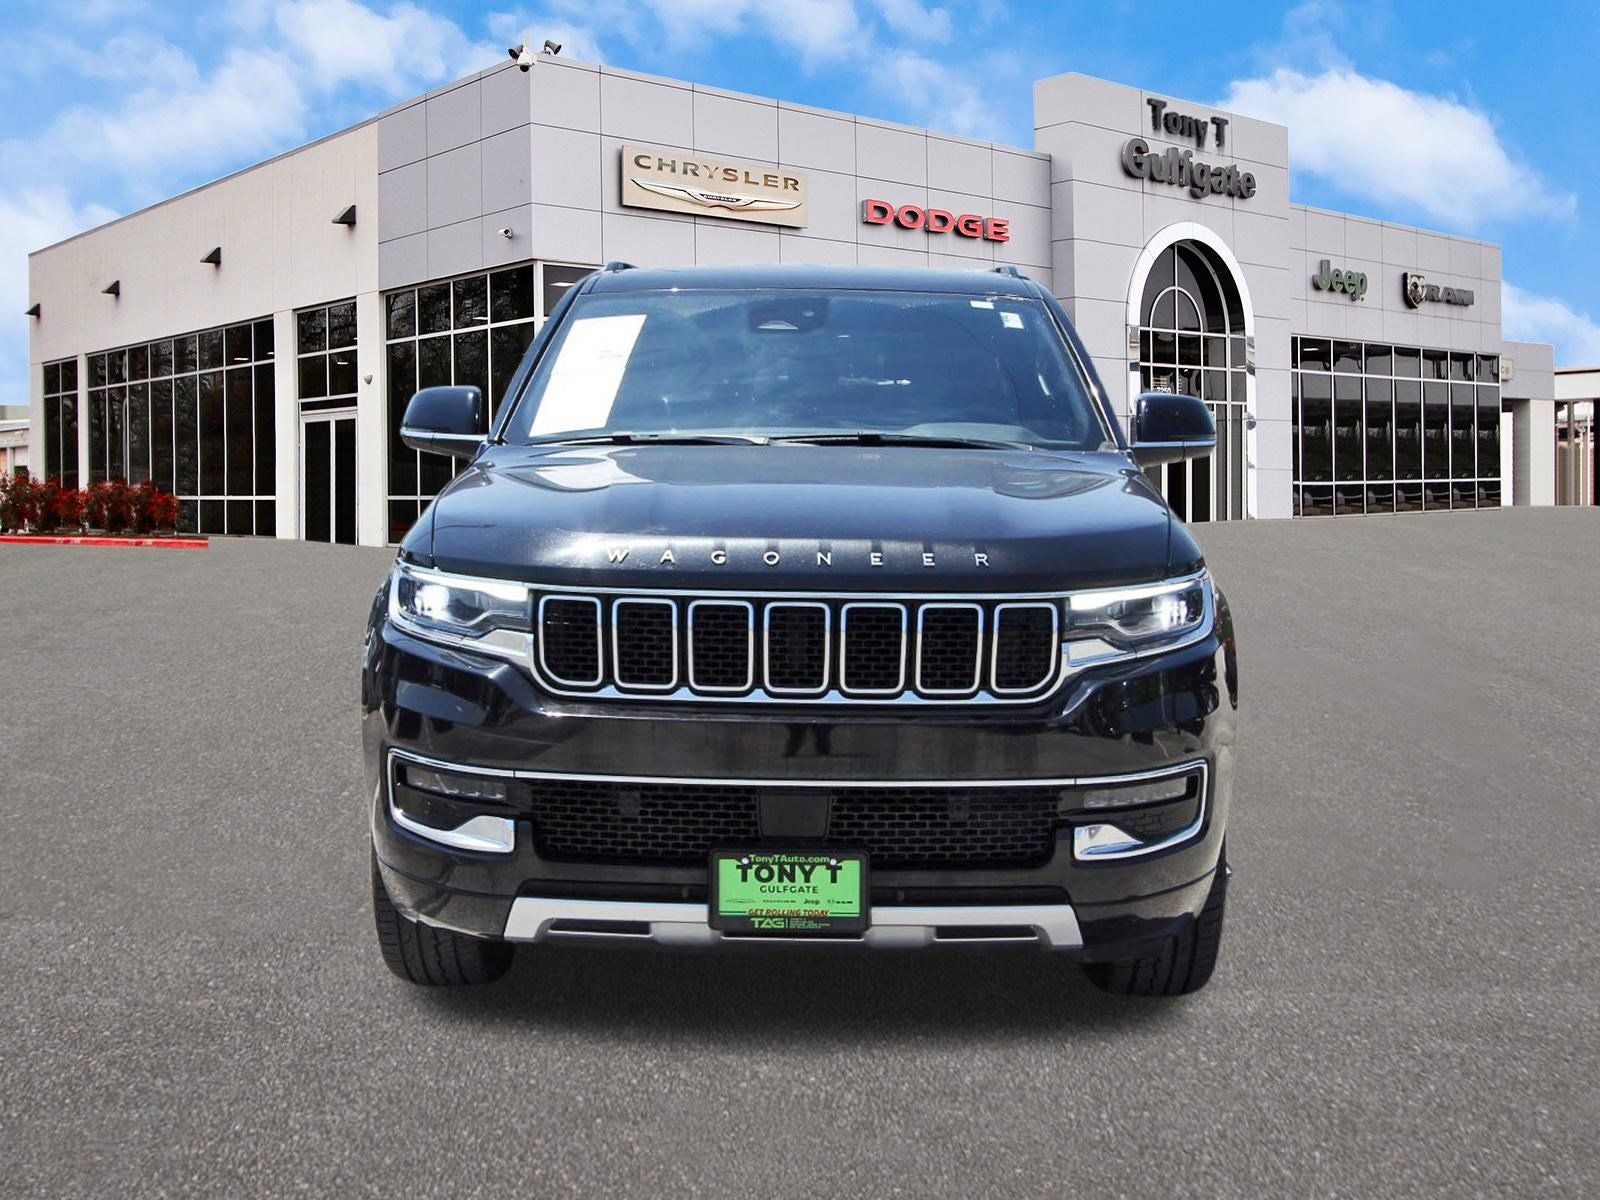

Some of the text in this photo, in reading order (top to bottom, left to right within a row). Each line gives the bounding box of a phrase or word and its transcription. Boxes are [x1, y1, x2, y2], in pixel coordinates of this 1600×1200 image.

[1147, 98, 1229, 147] Tony T
[633, 154, 800, 192] CHRYSLER
[1121, 138, 1257, 199] Gulfgate
[862, 199, 1010, 242] DODGE
[1312, 260, 1368, 302] Jeep
[1425, 284, 1475, 306] RAM
[607, 550, 989, 567] WAGONEER
[749, 854, 830, 864] TonyTAuto.com
[736, 864, 842, 883] TONY T
[759, 885, 818, 894] GULFGATE
[748, 909, 829, 917] GET ROLLING TODAY
[750, 918, 785, 929] TAG
